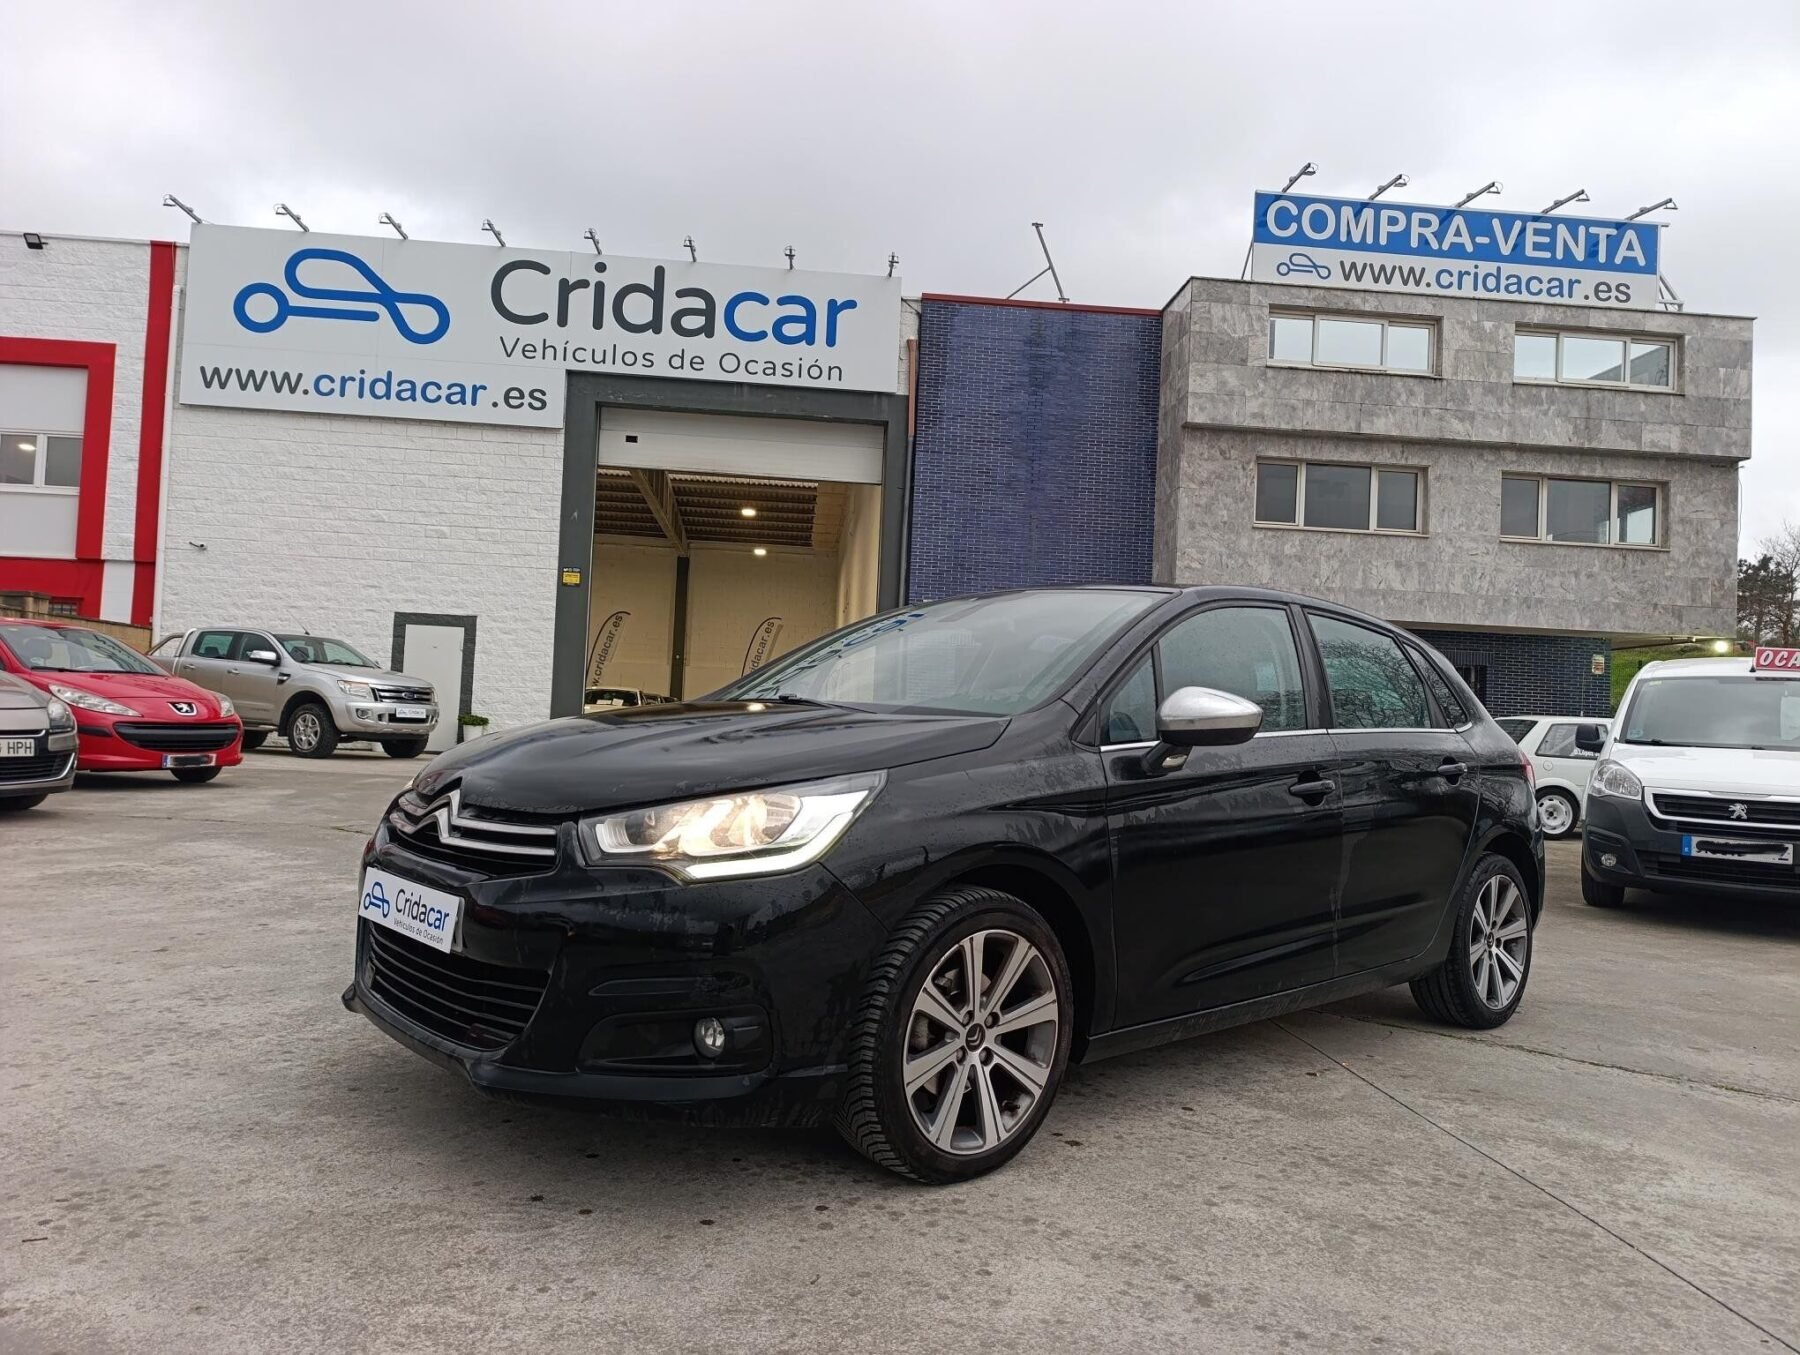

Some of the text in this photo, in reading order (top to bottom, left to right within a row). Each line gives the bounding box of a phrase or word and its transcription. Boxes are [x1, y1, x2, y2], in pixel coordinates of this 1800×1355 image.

[1267, 200, 1646, 267] COMPRA-VENTA
[490, 260, 858, 347] Cridacar
[1340, 259, 1632, 303] www.cridacar.es
[500, 335, 843, 382] Vehículos de Ocasión
[200, 365, 548, 411] www.cridacar.es
[7, 741, 32, 755] HPH
[395, 888, 450, 932] Cridacar
